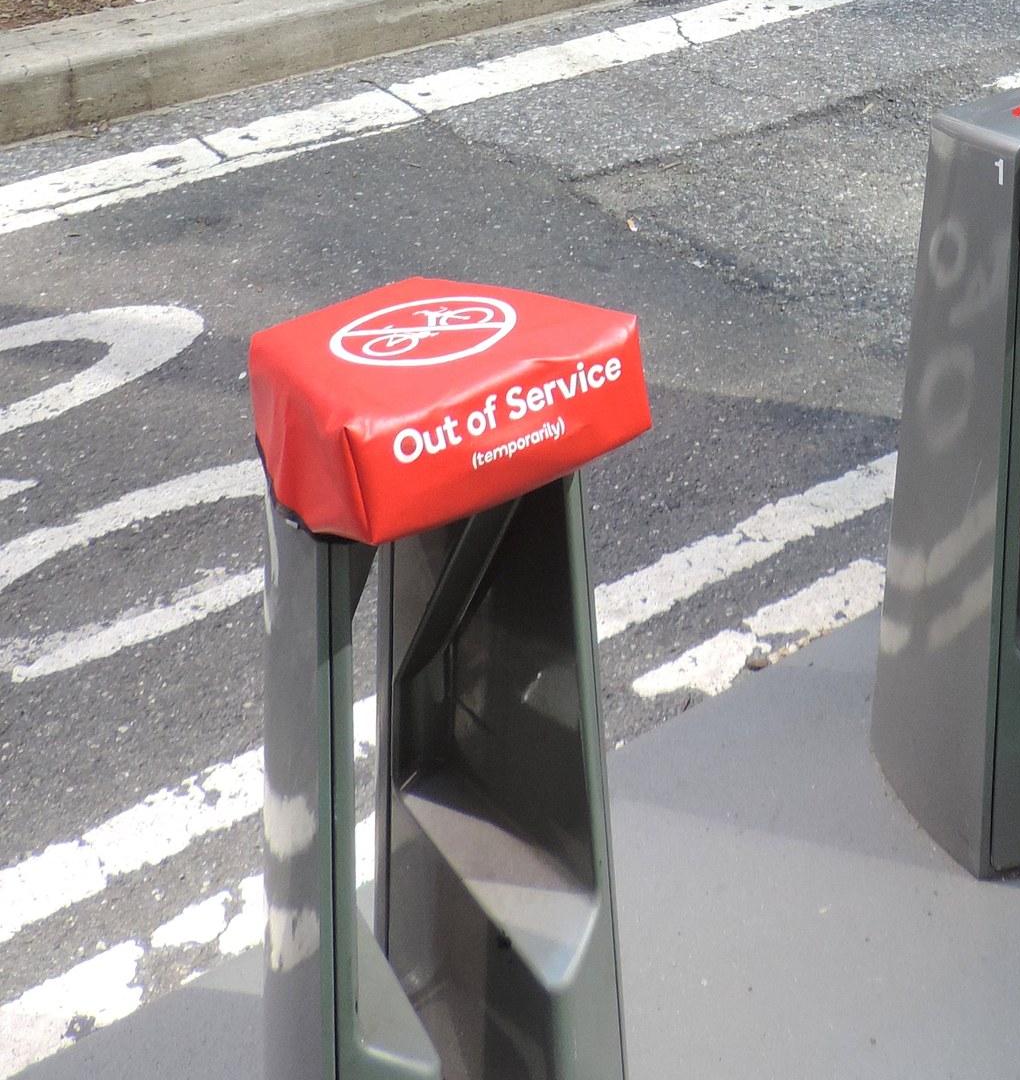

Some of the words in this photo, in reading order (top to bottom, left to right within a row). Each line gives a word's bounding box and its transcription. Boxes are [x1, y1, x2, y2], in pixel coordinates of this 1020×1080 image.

[995, 158, 1004, 186] 1
[393, 415, 462, 464] Out
[466, 394, 499, 436] of
[506, 356, 622, 420] Service
[472, 416, 566, 470] (temporarily)
